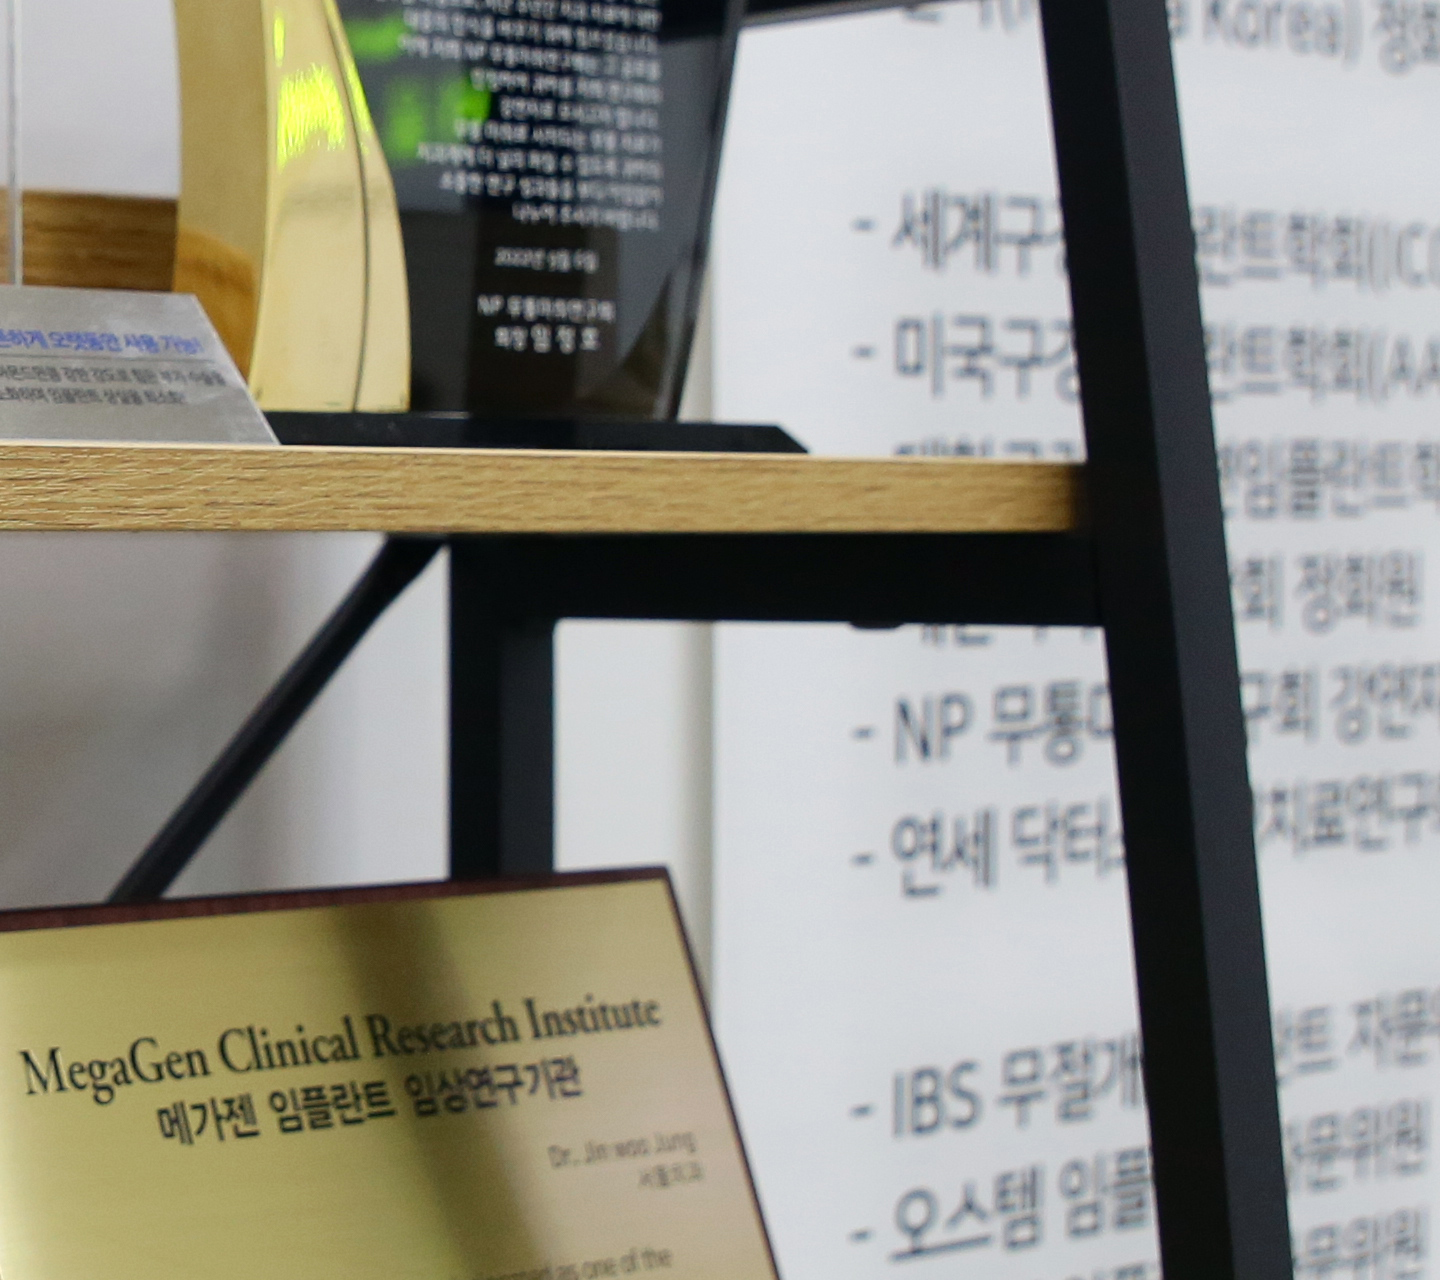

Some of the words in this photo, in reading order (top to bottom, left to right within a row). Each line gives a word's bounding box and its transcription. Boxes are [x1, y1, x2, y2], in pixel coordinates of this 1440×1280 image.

[893, 694, 974, 766] NP
[20, 1037, 210, 1105] MegaGen
[219, 1014, 363, 1073] Clinical
[365, 999, 521, 1059] Research
[523, 992, 661, 1040] Institute
[157, 1092, 260, 1145] 메가젠
[269, 1080, 397, 1134] 임플란트
[891, 1063, 981, 1140] IBS
[889, 1163, 1046, 1261] 오스템
